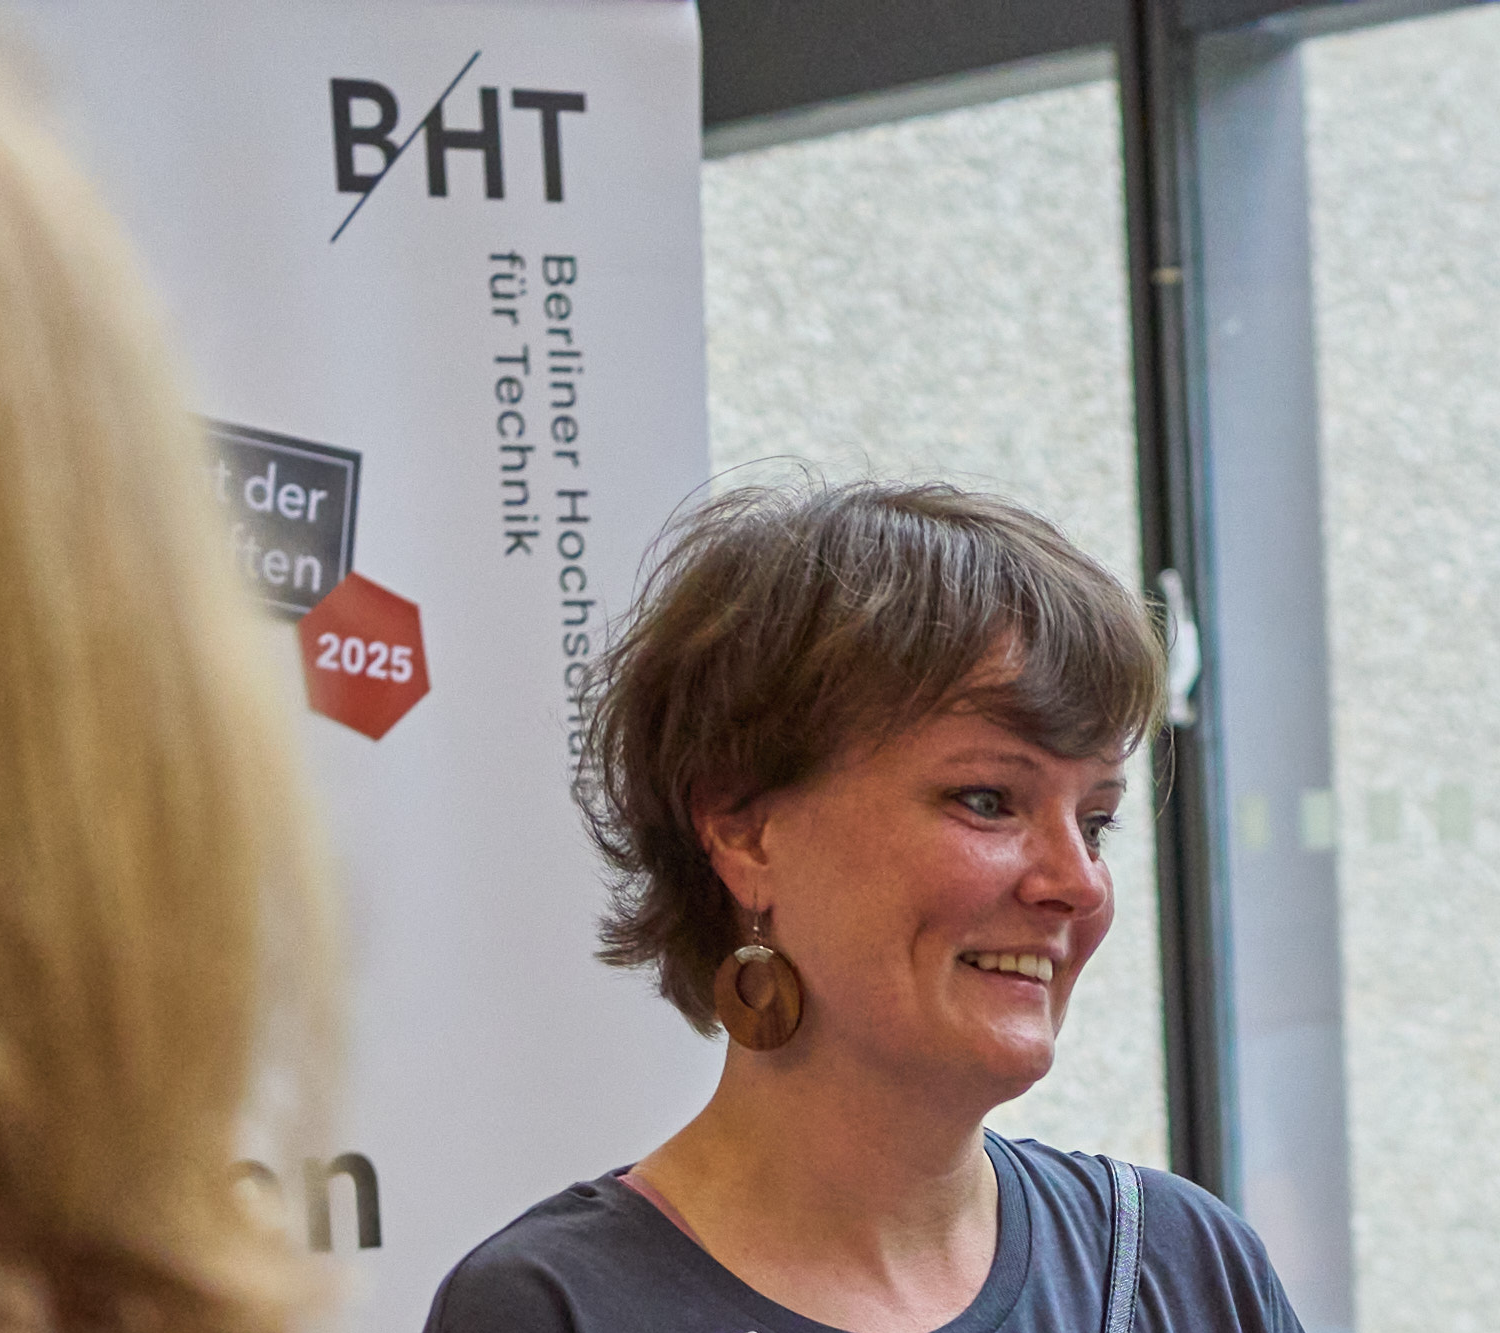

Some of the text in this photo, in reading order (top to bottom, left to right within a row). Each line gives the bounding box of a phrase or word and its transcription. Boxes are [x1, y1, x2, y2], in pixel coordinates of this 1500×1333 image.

[488, 250, 540, 556] für Technik
[541, 254, 584, 468] Berliner
[243, 461, 329, 523] der
[315, 631, 414, 683] 2025
